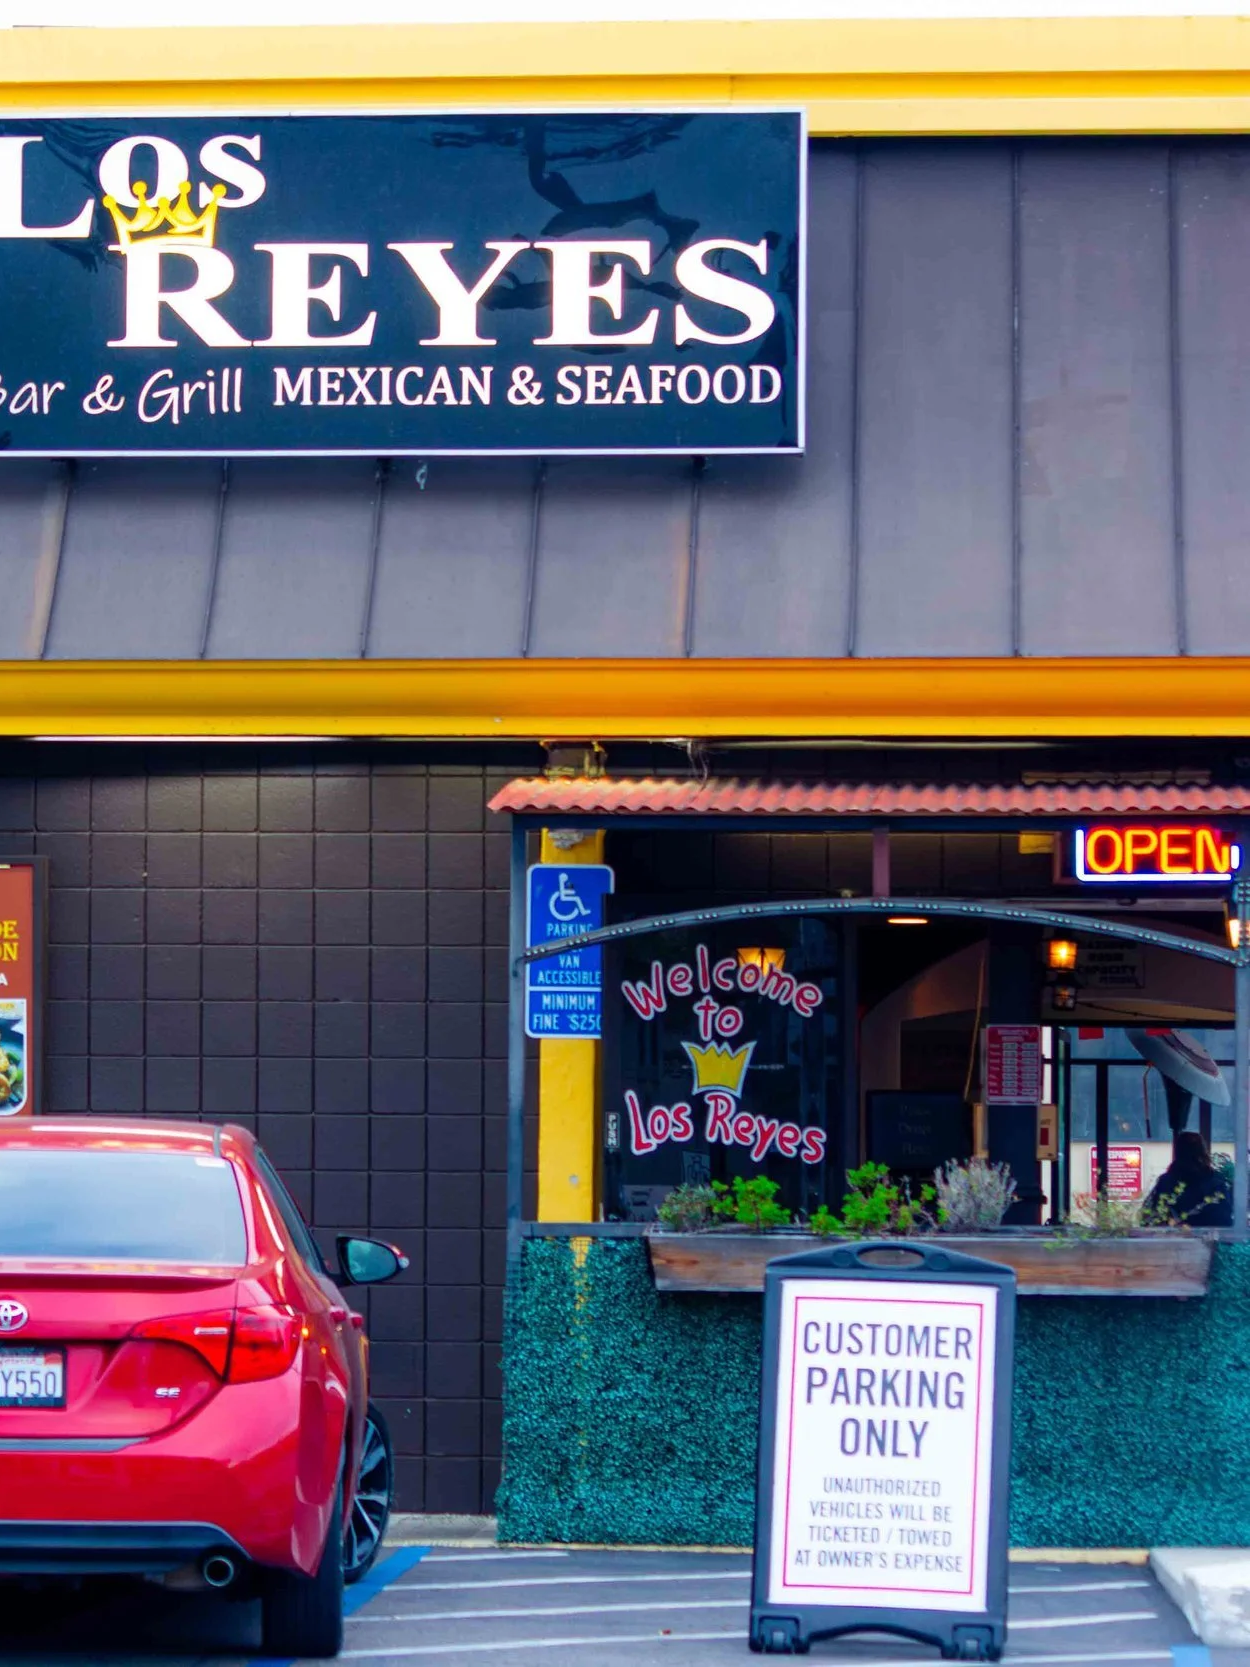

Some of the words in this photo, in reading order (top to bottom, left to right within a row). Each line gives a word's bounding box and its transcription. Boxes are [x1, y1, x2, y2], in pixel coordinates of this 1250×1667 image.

[107, 238, 776, 348] REYES
[82, 374, 125, 415] &
[138, 367, 242, 424] Grill
[273, 366, 493, 406] MEXICAN
[507, 365, 545, 406] &
[556, 364, 782, 405] SEAFOOD
[1086, 828, 1231, 874] OPEN
[537, 970, 602, 985] ACCESSIBLE
[559, 955, 580, 968] VAN
[542, 994, 596, 1010] MINIMUM
[621, 944, 823, 1021] Welcome
[532, 1013, 560, 1030] FINE
[693, 995, 743, 1041] to
[625, 1089, 694, 1156] Los
[704, 1091, 827, 1164] Reyes
[803, 1320, 973, 1360] CUSTOMER
[805, 1366, 965, 1410] PARKING
[840, 1417, 929, 1458] ONLY
[823, 1476, 941, 1498] UNAUTHORIZED
[809, 1500, 883, 1520] VEHICLES
[889, 1503, 927, 1521] WILL
[933, 1506, 953, 1523] BE
[808, 1525, 880, 1544] TICKETED
[886, 1528, 893, 1544] /
[898, 1528, 952, 1547] TOWED
[795, 1549, 810, 1566] AT
[817, 1550, 888, 1569] OWNER'S
[894, 1553, 964, 1573] EXPENSE
